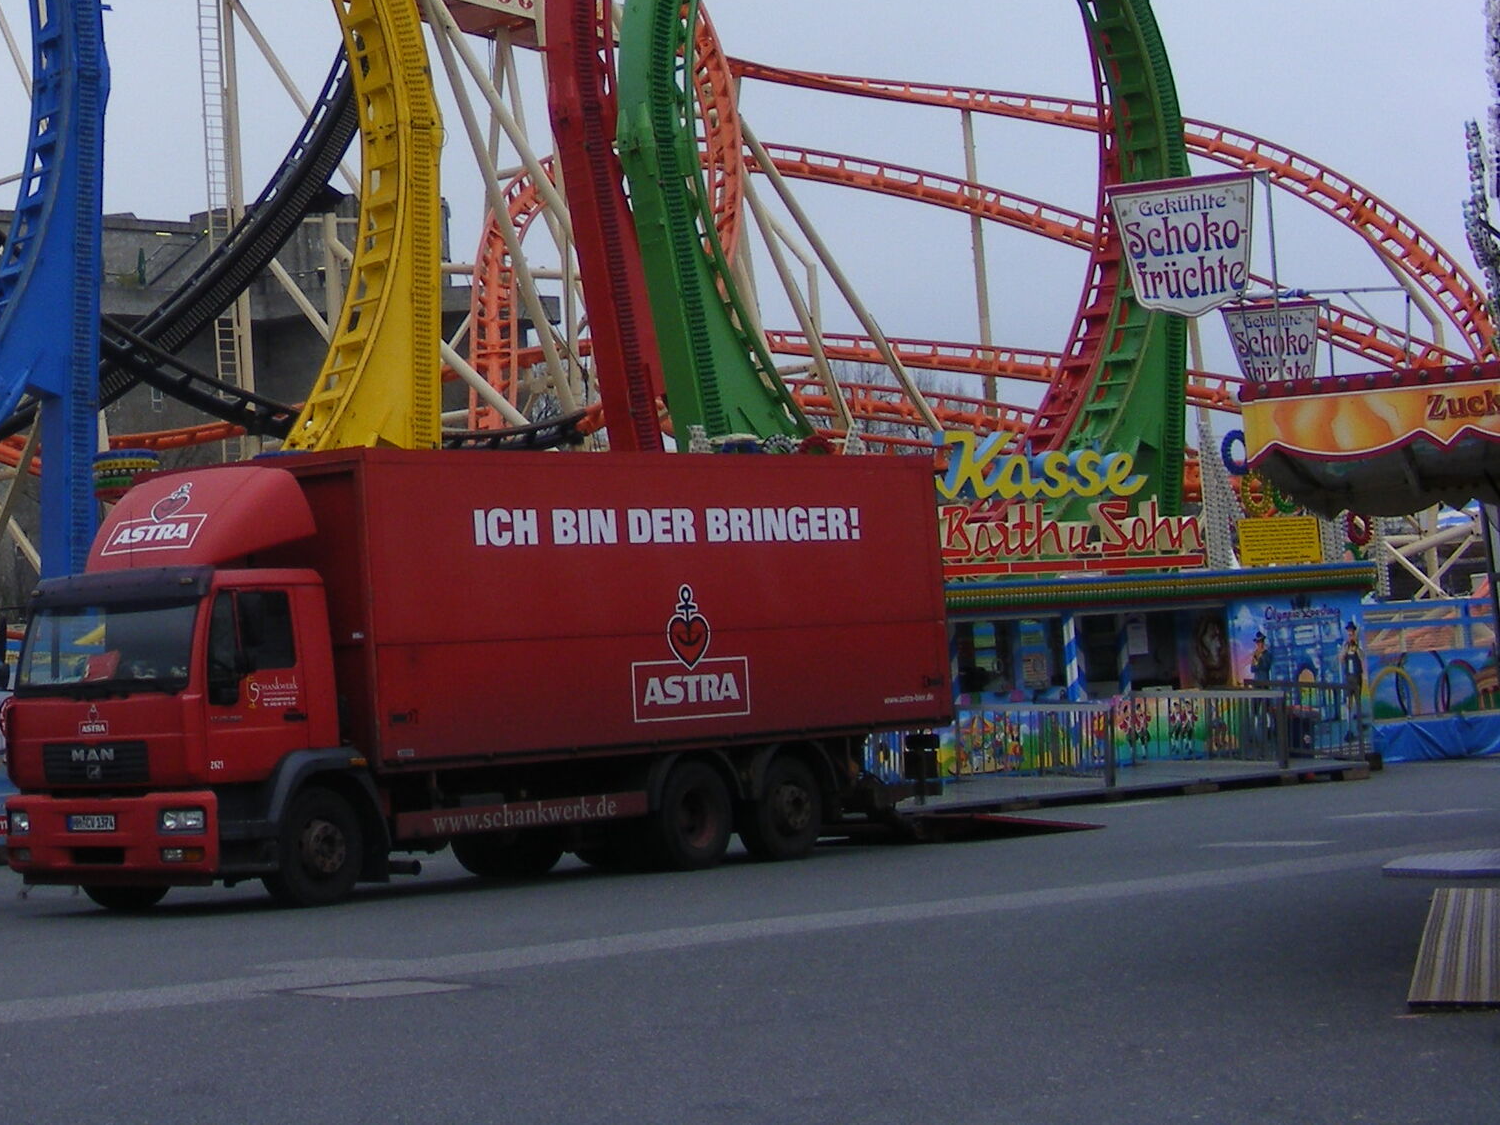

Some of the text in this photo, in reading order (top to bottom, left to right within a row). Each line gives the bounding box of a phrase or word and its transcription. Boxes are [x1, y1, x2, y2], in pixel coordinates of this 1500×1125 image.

[1138, 194, 1227, 217] Gekühlte
[1125, 212, 1247, 259] Schoko-
[1136, 255, 1245, 299] früchte
[935, 431, 1148, 499] Kasse
[113, 522, 189, 546] ASTRA
[474, 507, 860, 546] ICH BIN DER BRINGER!
[942, 502, 1064, 557] Barth
[1069, 525, 1098, 554] u.
[1098, 500, 1204, 552] Sohn
[644, 672, 740, 706] ASTRA
[82, 724, 105, 733] ASTRA
[71, 748, 115, 761] MAN
[432, 794, 617, 835] www.schankwerk.de
